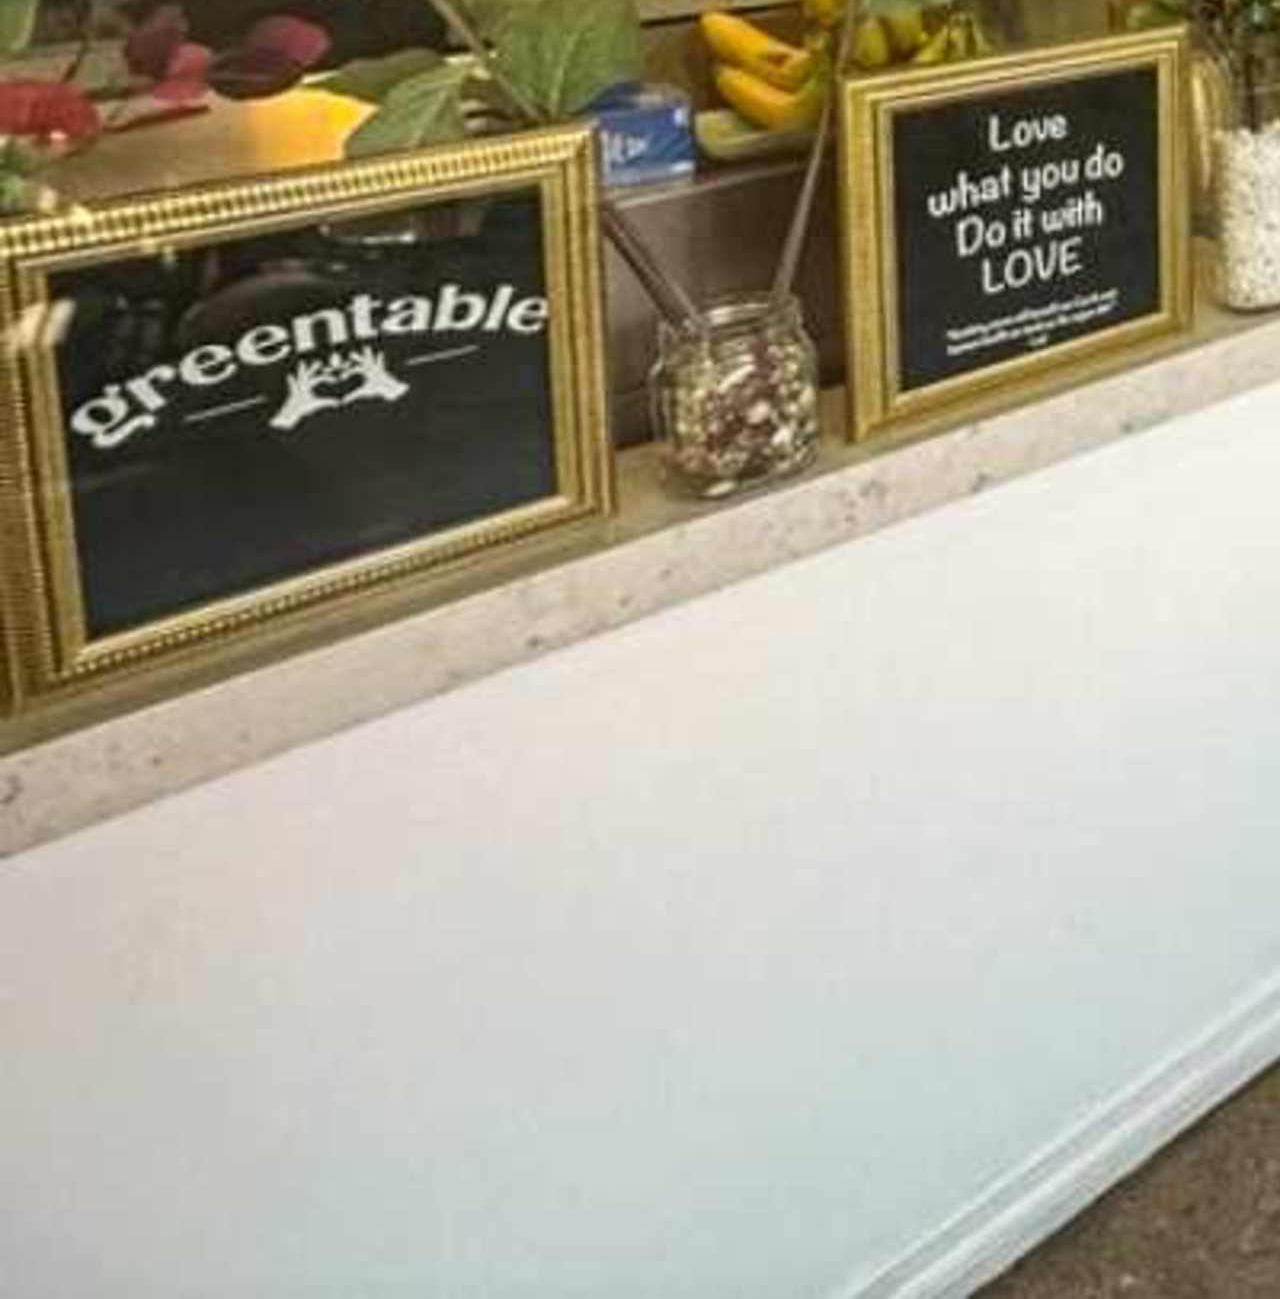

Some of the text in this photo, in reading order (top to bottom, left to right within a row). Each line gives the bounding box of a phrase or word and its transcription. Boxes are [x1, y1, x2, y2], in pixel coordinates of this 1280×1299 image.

[988, 113, 1068, 152] Love
[926, 141, 1125, 218] what you do
[955, 189, 1105, 258] Do it with
[981, 235, 1084, 296] LOVE
[71, 283, 550, 450] greentable
